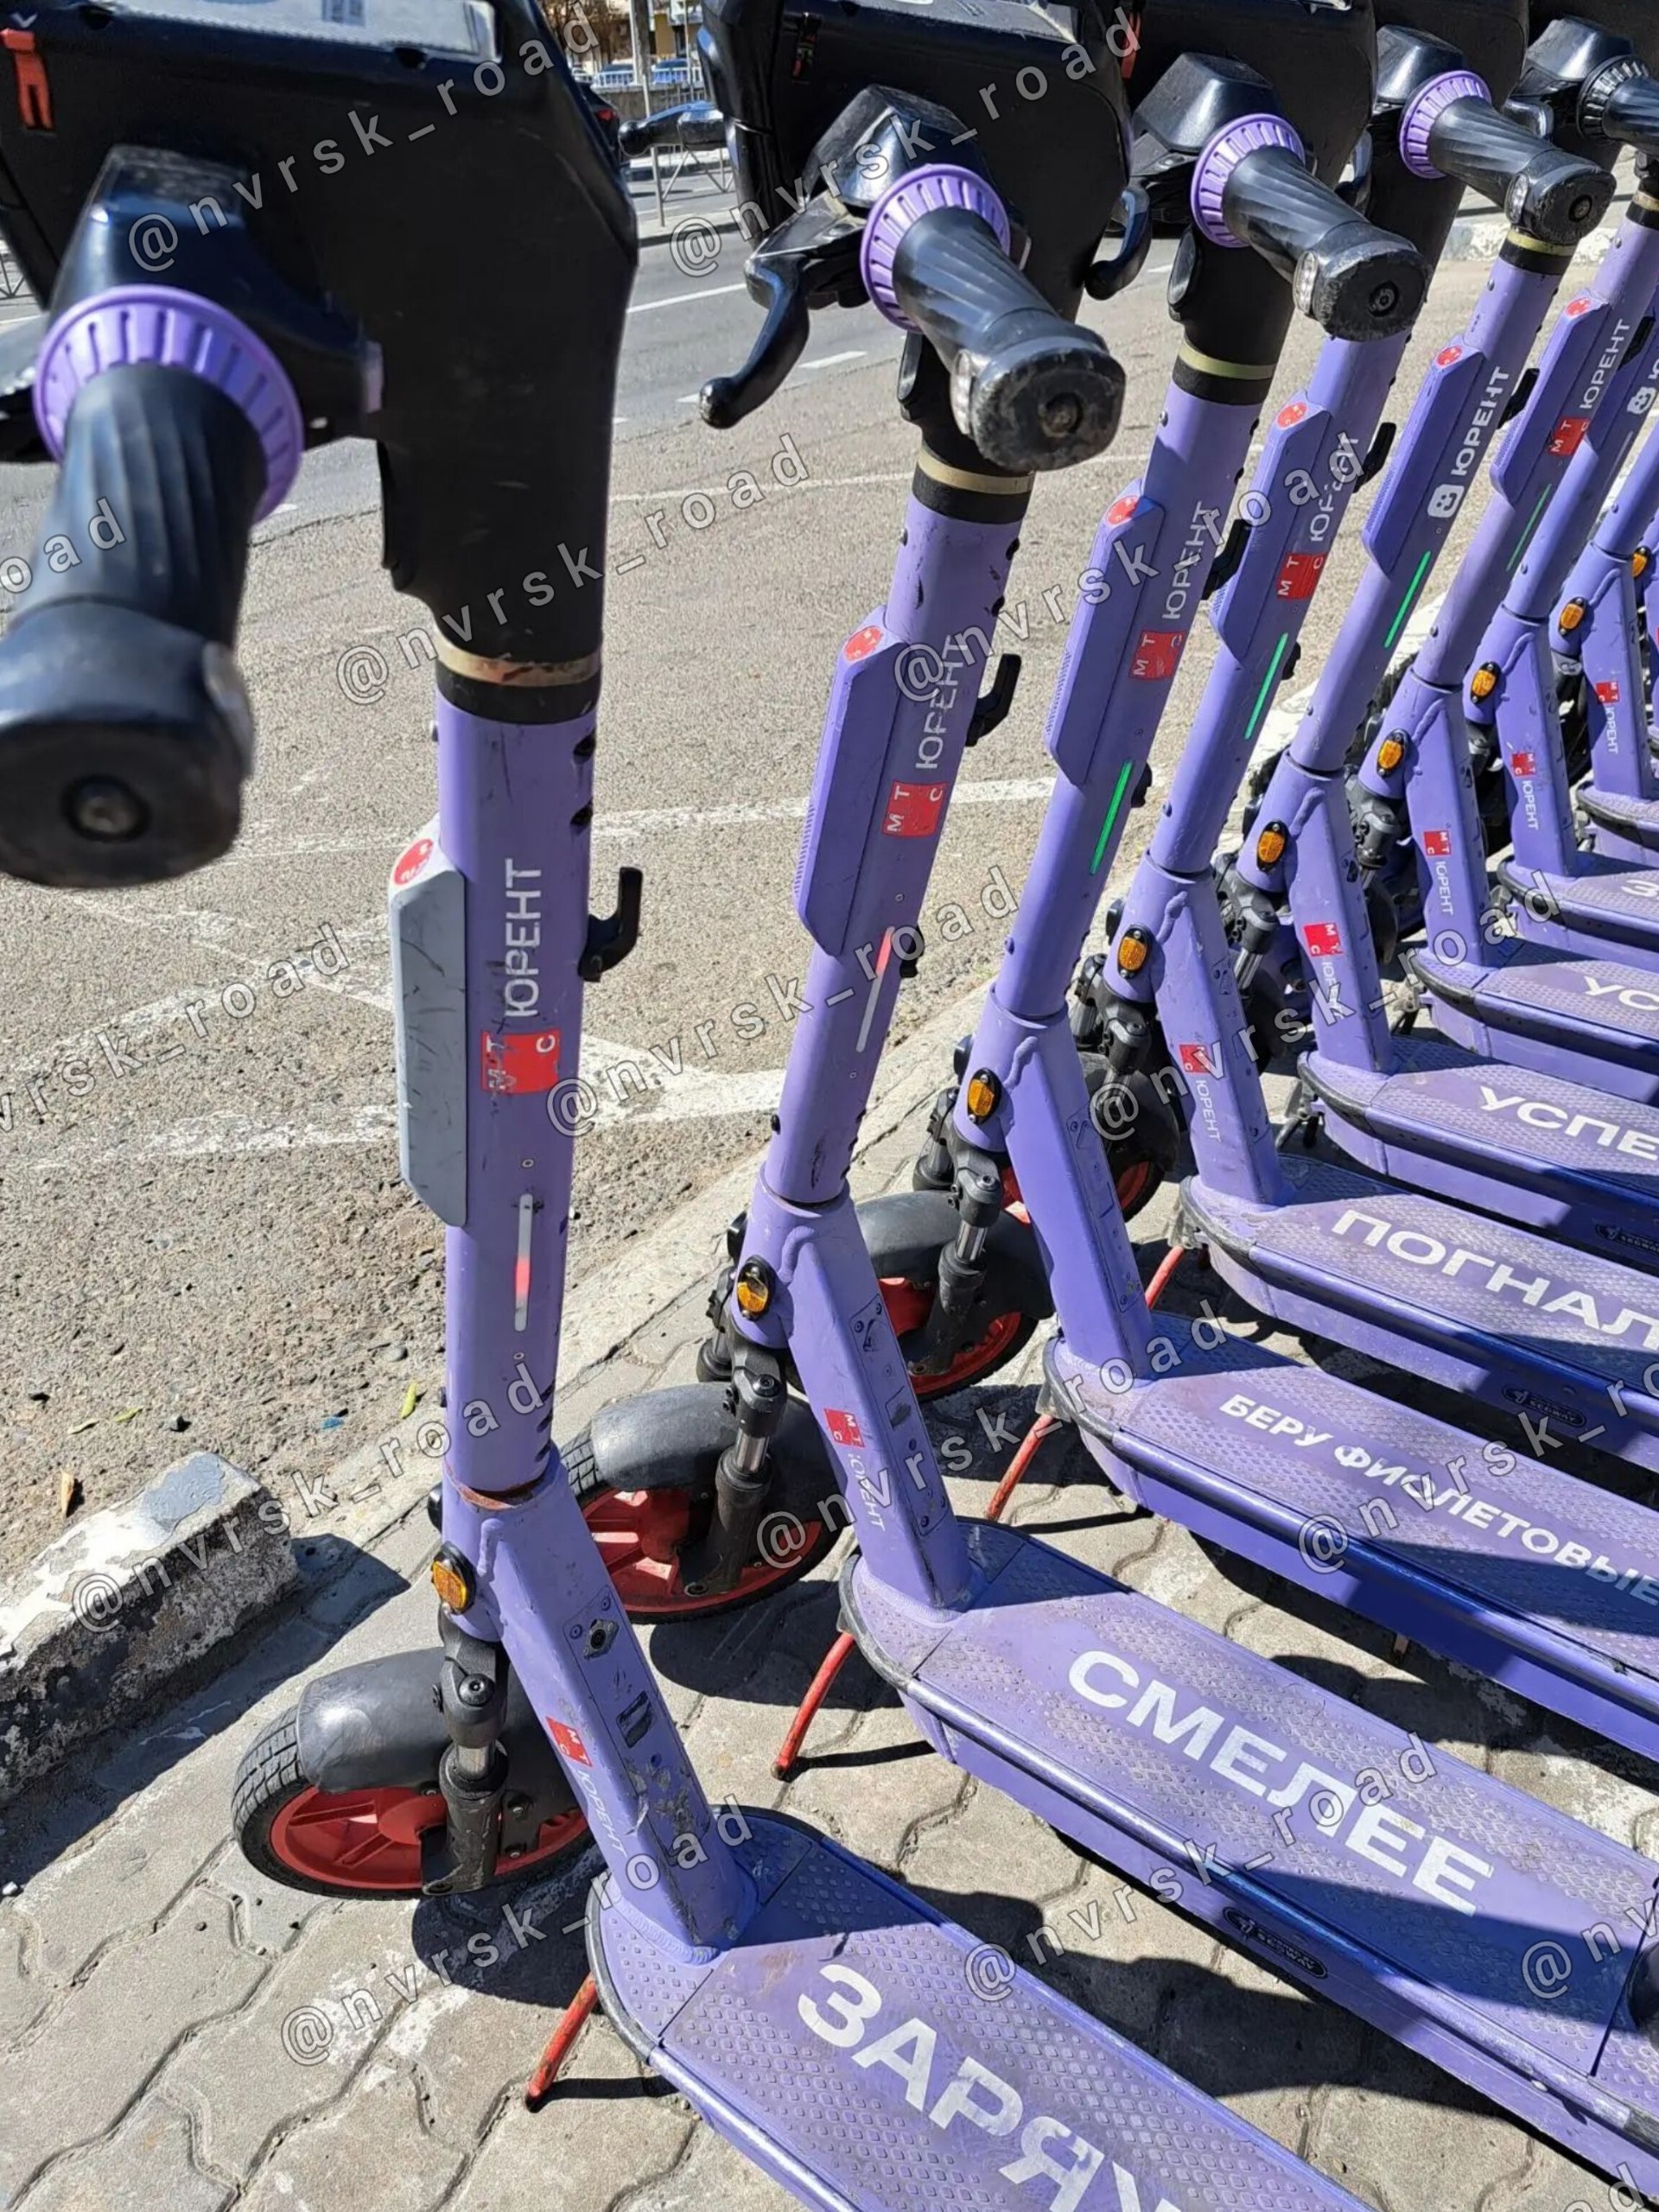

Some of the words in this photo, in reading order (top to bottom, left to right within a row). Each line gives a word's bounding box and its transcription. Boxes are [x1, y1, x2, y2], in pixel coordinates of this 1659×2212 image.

[1580, 319, 1630, 410] ЮРЕНТ
[1452, 366, 1510, 475] ЮРЕНТ
[1605, 707, 1619, 754] ЮРЕНТ
[1522, 780, 1540, 830] ЮРЕНТ
[1435, 861, 1453, 916] ЮРЕНТ
[505, 858, 542, 1017] ЮРЕНТ
[1196, 1079, 1221, 1142] ЮРЕНТ
[1480, 1085, 1659, 1161] УСПЕ
[1219, 1394, 1334, 1448] БЕРУ
[577, 1769, 629, 1859] ЮРЕНТ
[1069, 1650, 1495, 1916] СМЕЛЕЕ
